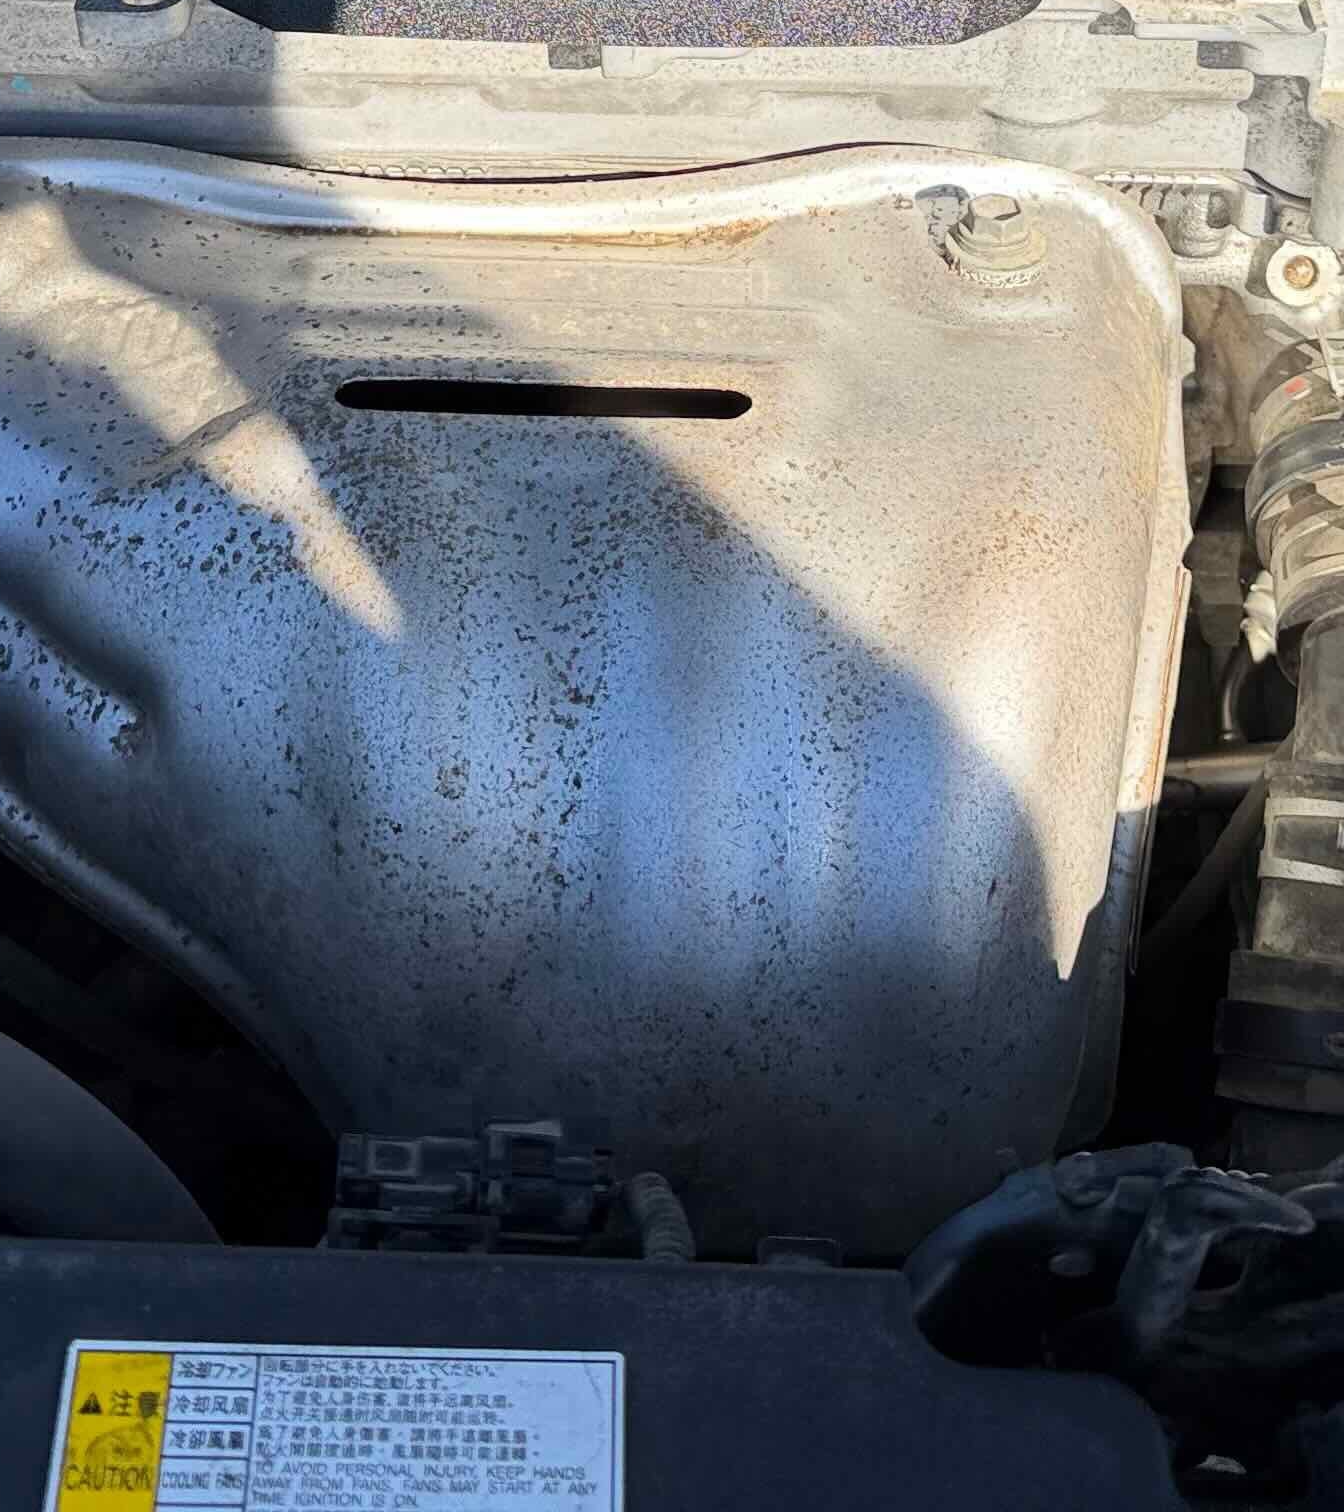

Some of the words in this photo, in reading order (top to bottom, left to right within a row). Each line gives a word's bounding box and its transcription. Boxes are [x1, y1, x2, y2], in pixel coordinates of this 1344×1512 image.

[64, 1463, 151, 1492] CAUTION
[161, 1471, 210, 1489] COOLING
[281, 1462, 328, 1475] AVOID
[336, 1464, 412, 1477] PERSONAL
[486, 1466, 526, 1480] KEEP
[533, 1466, 586, 1480] HANDS
[251, 1476, 291, 1489] AWAY
[301, 1477, 344, 1491] FROM
[449, 1480, 480, 1493] MAY
[487, 1480, 533, 1494] START
[542, 1481, 561, 1494] AT
[567, 1482, 598, 1495] ANY
[295, 1492, 362, 1506] IGNITION
[371, 1493, 385, 1506] IS
